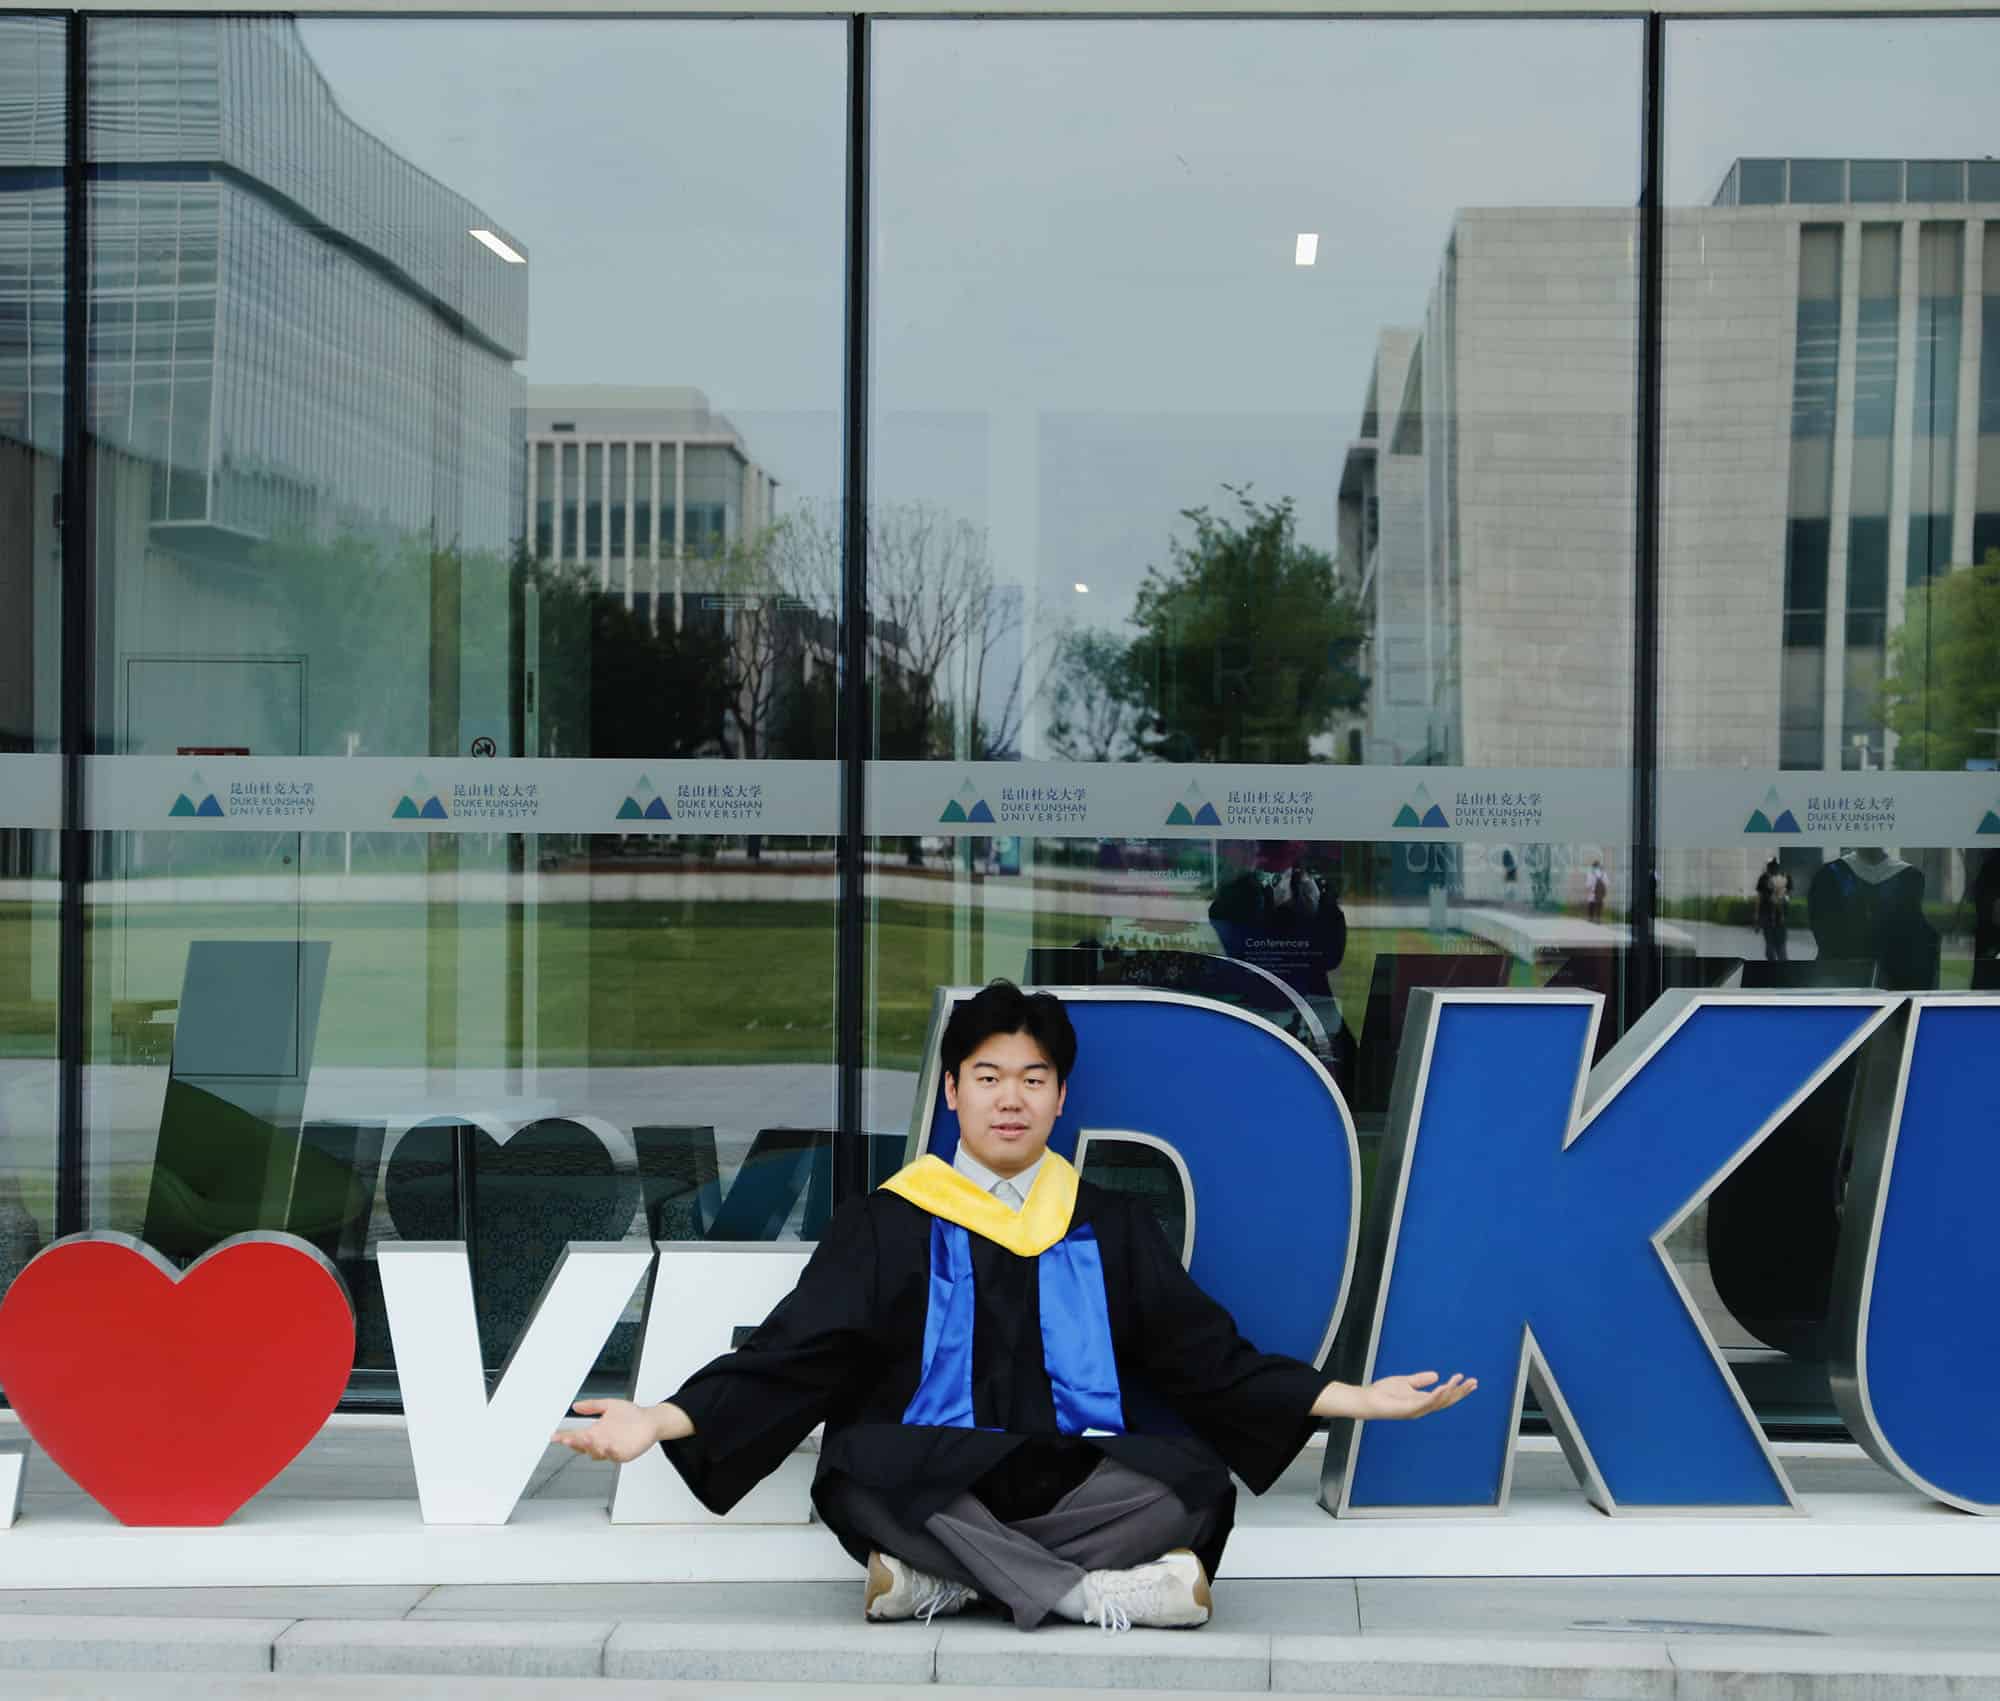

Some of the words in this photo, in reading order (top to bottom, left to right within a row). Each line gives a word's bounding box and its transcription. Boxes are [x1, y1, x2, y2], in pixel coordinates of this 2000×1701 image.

[231, 782, 314, 794] 昆山杜克大学
[455, 784, 537, 796] 昆山杜克大学
[678, 785, 761, 797] 昆山杜克大学
[1001, 788, 1086, 800] 昆山杜克大学
[1228, 791, 1312, 804] 昆山杜克大学
[231, 797, 260, 806] DUKE
[262, 797, 315, 806] KUNSHAN
[454, 799, 484, 807] DUKE
[486, 799, 538, 807] KUNSHAN
[677, 799, 707, 808] DUKE
[710, 799, 762, 808] KUNSHAN
[1456, 793, 1542, 805] 昆山杜克大学
[1808, 797, 1894, 810] 昆山杜克大学
[231, 807, 314, 815] UNIVERSITY
[454, 808, 537, 816] UNIVERSITY
[1001, 803, 1031, 812] DUKE
[1035, 803, 1087, 812] KUNSHAN
[1228, 806, 1257, 815] DUKE
[1261, 806, 1313, 815] KUNSHAN
[1456, 807, 1486, 816] DUKE
[1489, 807, 1542, 816] KUNSHAN
[677, 809, 761, 818] UNIVERSITY
[1001, 813, 1086, 822] UNIVERSITY
[1808, 813, 1837, 821] DUKE
[1840, 813, 1895, 822] KUNSHAN
[1228, 816, 1312, 825] UNIVERSITY
[1456, 817, 1541, 826] UNIVERSITY
[1808, 823, 1893, 832] UNIVERSITY
[1246, 938, 1310, 949] Conferences
